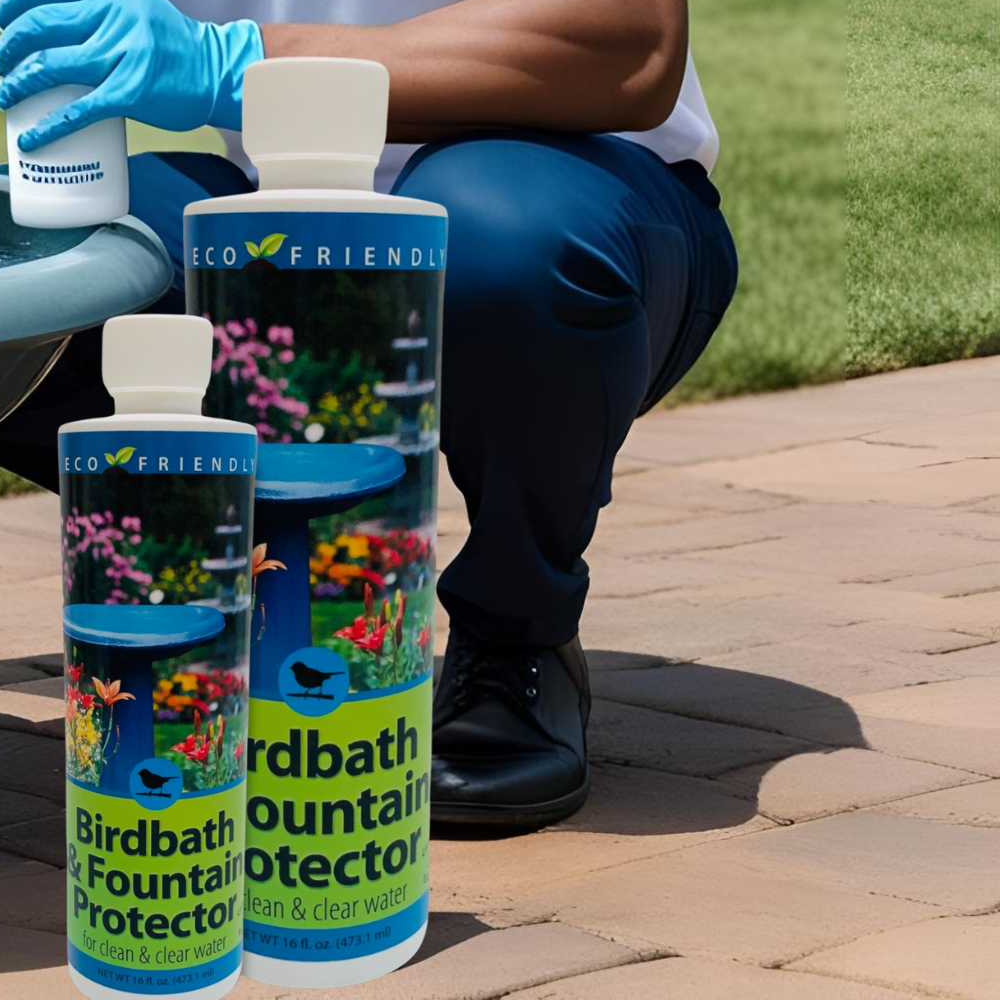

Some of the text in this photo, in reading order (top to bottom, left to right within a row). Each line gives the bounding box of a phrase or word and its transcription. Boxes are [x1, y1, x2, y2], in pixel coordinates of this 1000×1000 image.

[193, 246, 445, 267] ECO FRIENDLY
[65, 456, 98, 472] ECO
[247, 716, 418, 778] rdbath
[246, 769, 429, 835] ountain
[76, 806, 234, 857] Birdbath
[67, 842, 243, 900] & Fountain
[244, 826, 421, 888] otector
[73, 884, 237, 939] Protector
[291, 896, 306, 921] &
[313, 897, 359, 921] clear
[364, 883, 407, 915] water
[83, 930, 227, 964] for clean & clear water
[244, 929, 258, 941] ET
[259, 933, 279, 946] WT
[283, 937, 298, 949] 16
[301, 937, 312, 949] fl.
[314, 941, 333, 950] oz.
[335, 932, 371, 949] (473.1
[374, 925, 391, 941] ml)
[97, 967, 114, 979] NET
[115, 972, 129, 983] WT
[133, 976, 144, 985] 16
[156, 978, 170, 986] oz.
[172, 972, 199, 986] (473.1
